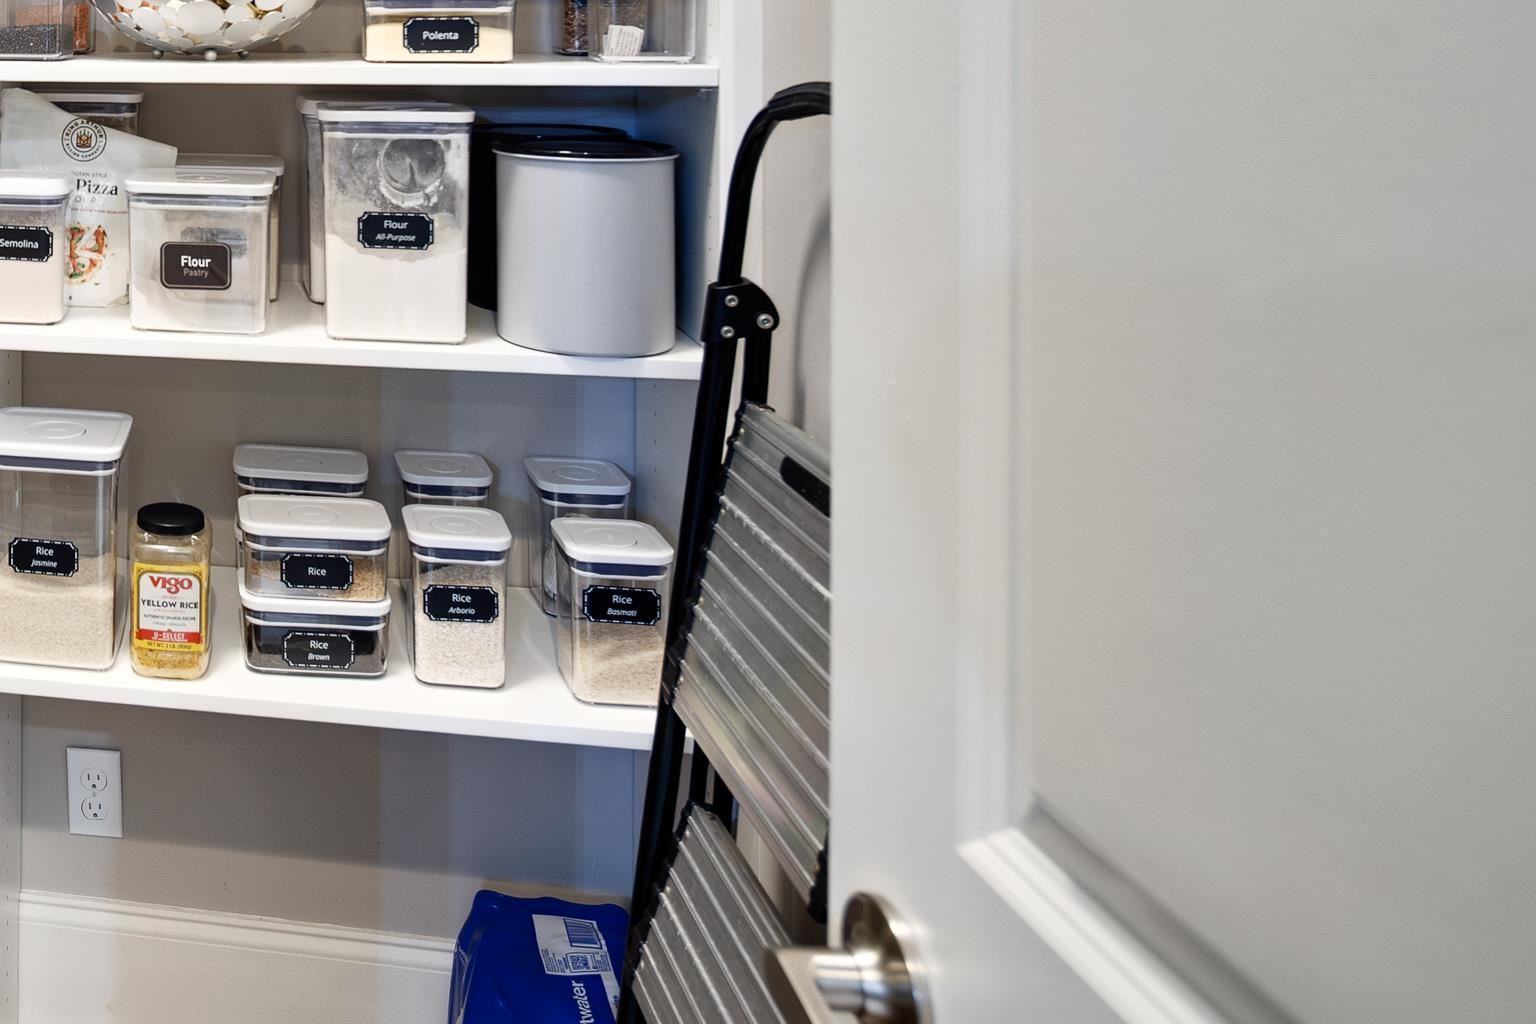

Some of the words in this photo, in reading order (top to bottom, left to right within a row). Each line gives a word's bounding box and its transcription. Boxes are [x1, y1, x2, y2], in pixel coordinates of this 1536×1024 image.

[422, 31, 459, 40] Polenta
[76, 178, 118, 197] Pizza
[383, 220, 408, 230] Flour
[375, 233, 416, 242] All-Purpose
[0, 237, 39, 250] Semolina
[180, 255, 212, 267] Flour
[183, 268, 210, 279] Pastry
[36, 547, 54, 556] Rice
[31, 559, 58, 568] Jasmine
[308, 567, 327, 576] Rice
[451, 593, 471, 603] Rice
[612, 594, 632, 604] Rice
[141, 598, 177, 608] YELLOW
[180, 600, 199, 609] RICE
[448, 606, 475, 615] Arborio
[607, 607, 637, 617] Basmati
[309, 640, 328, 649] Rice
[308, 652, 330, 661] Brown
